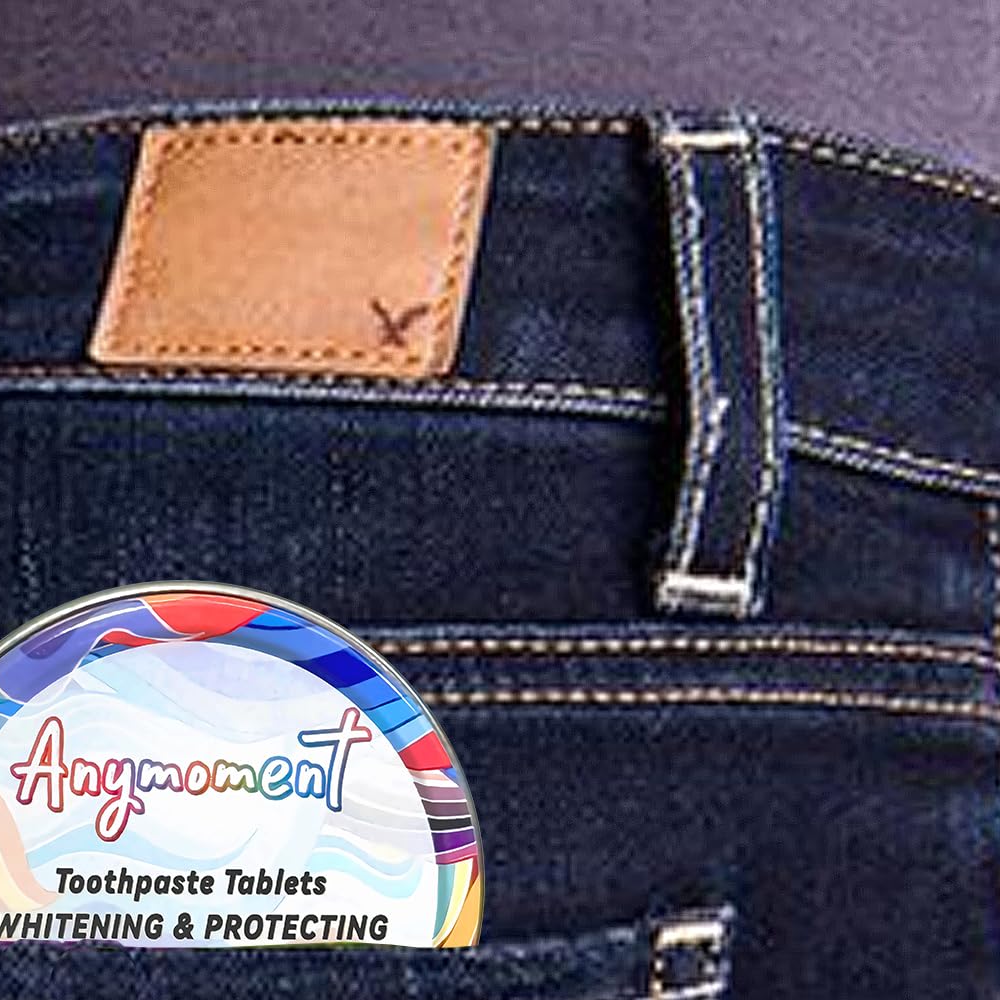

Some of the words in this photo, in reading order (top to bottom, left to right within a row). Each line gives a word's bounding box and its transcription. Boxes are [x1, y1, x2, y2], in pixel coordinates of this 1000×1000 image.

[10, 707, 372, 842] Anymoment
[55, 868, 215, 901] Toothpaste
[225, 868, 327, 896] Tablets
[173, 912, 195, 940] &
[204, 914, 389, 942] PROTECTING
